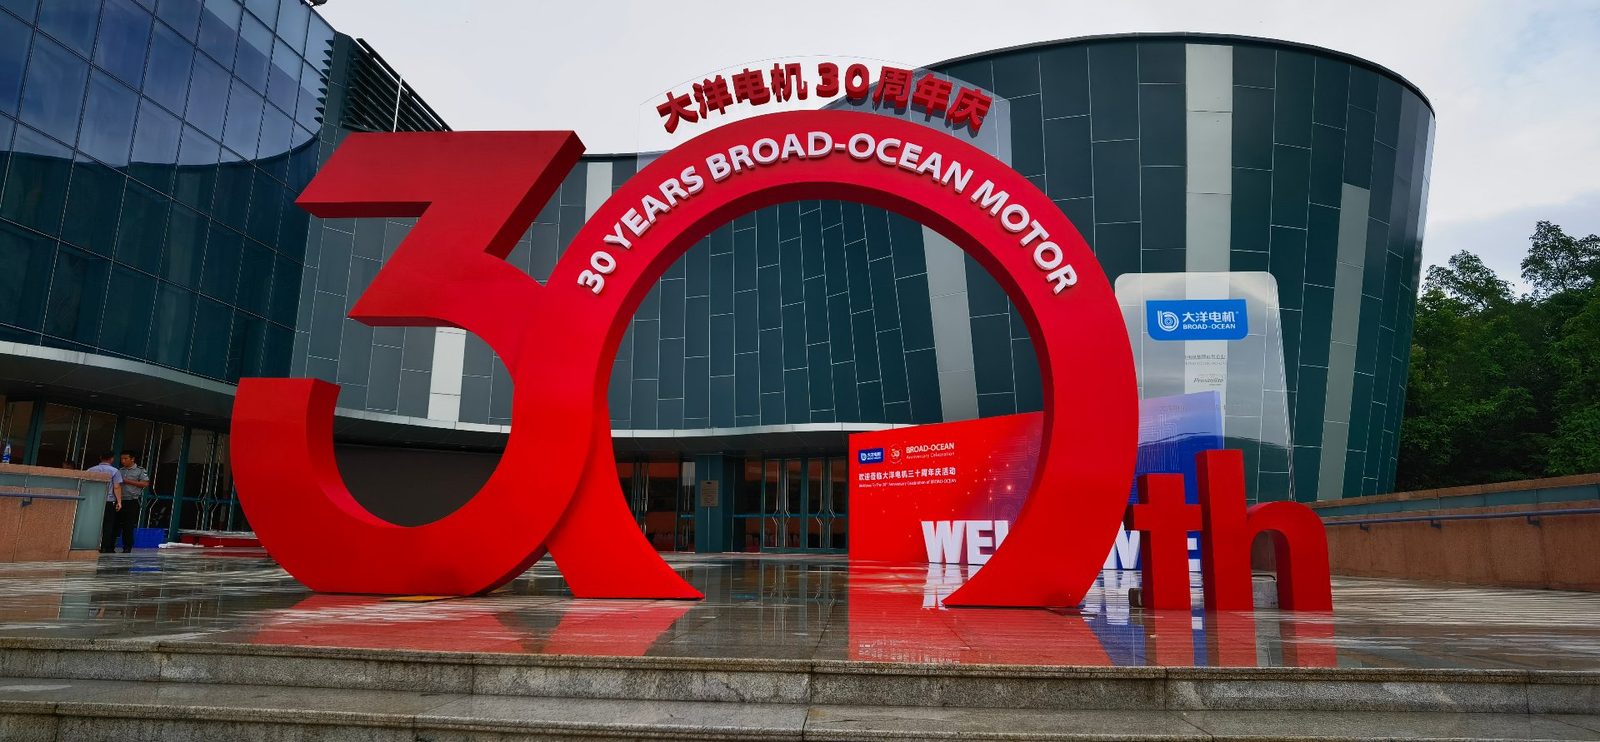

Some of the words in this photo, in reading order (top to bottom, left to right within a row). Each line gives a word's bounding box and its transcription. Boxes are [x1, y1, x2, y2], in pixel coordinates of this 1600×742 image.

[577, 250, 617, 295] 30
[603, 165, 704, 250] YEARS
[706, 131, 974, 194] BROAD-OCEAN
[970, 179, 1078, 295] MOTOR
[1182, 311, 1235, 323] 大洋电机
[905, 442, 955, 454] BROAD-OCEAN
